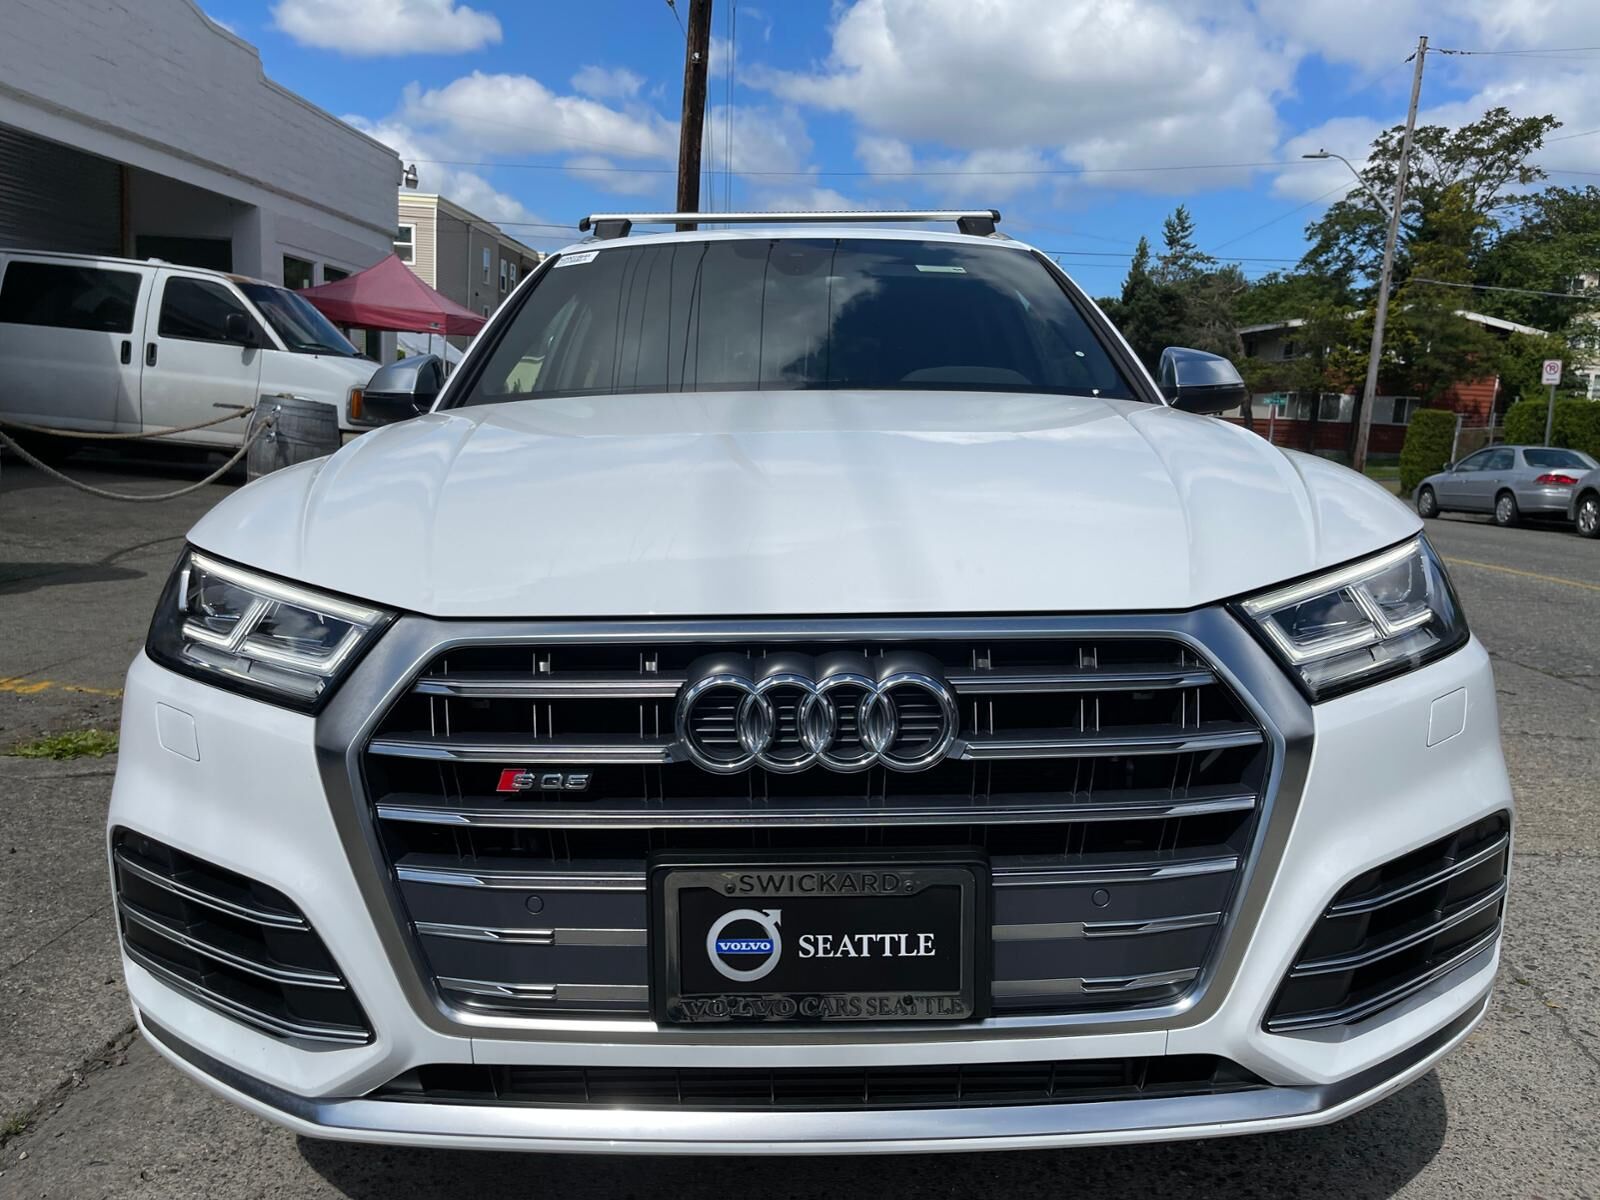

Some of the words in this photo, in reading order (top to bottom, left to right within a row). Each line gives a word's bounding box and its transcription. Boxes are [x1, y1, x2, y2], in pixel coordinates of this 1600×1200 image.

[512, 773, 588, 790] SQ5
[739, 874, 900, 893] SWICKARD
[718, 942, 771, 950] VOLVO
[799, 933, 936, 957] SEATTLE
[680, 997, 798, 1017] VOLVO
[799, 997, 862, 1017] CARS
